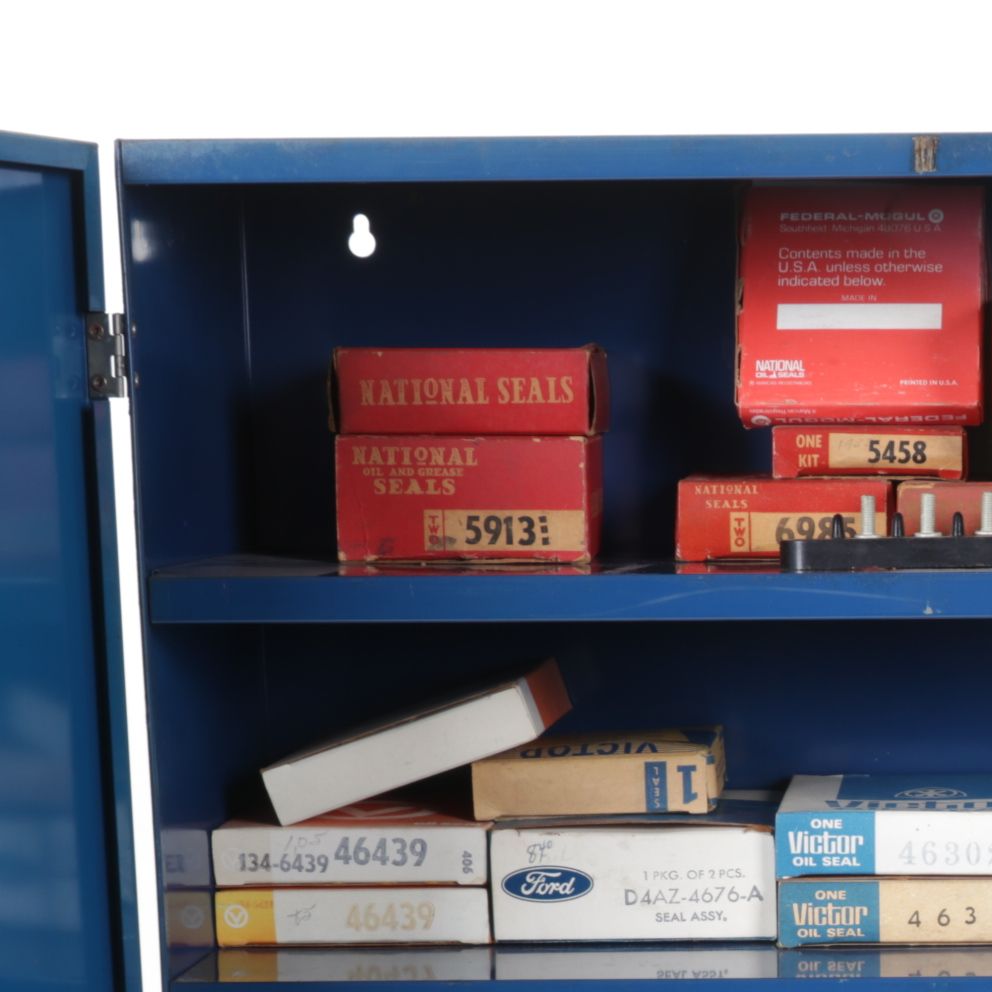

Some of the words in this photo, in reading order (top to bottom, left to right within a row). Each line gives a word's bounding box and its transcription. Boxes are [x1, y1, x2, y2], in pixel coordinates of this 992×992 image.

[778, 248, 842, 260] Contents
[846, 248, 884, 260] made
[889, 247, 900, 260] in
[904, 247, 926, 260] the
[778, 261, 820, 273] U.S.A.
[826, 261, 870, 273] unless
[875, 261, 943, 273] otherwise
[777, 275, 840, 287] indicated
[844, 275, 886, 287] below.
[755, 360, 805, 372] NATIONAL
[899, 379, 928, 387] PRINTED
[360, 377, 489, 406] NATIONAL
[497, 375, 575, 405] SEALS
[796, 434, 822, 449] ONE
[351, 446, 478, 467] NATIONAL
[867, 440, 927, 464] 5458
[798, 454, 820, 468] KIT
[362, 467, 384, 477] OIL
[389, 467, 415, 477] AND
[417, 467, 464, 477] GREASE
[373, 478, 456, 496] SEALS
[694, 484, 760, 496] NATIONAL
[705, 499, 748, 509] SEALS
[734, 517, 745, 548] TWO
[520, 741, 659, 759] VICTOR
[676, 764, 698, 805] 1
[810, 819, 842, 830] ONE
[788, 831, 864, 855] Victor
[334, 837, 428, 867] 46439
[237, 852, 329, 873] 134-6439
[792, 856, 817, 867] OIL
[822, 856, 861, 867] SEAL
[653, 869, 683, 881] PKG.
[687, 869, 706, 880] OF
[708, 869, 716, 880] 2
[718, 868, 746, 880] PCS.
[520, 870, 576, 897] Ford
[624, 884, 765, 907] D4AZ-4676-A
[815, 890, 847, 901] ONE
[344, 902, 435, 932] 46439
[655, 911, 687, 924] SEAL
[690, 910, 728, 923] ASSY.
[792, 903, 868, 926] Victor
[797, 928, 821, 938] OIL
[826, 927, 865, 938] SEAL
